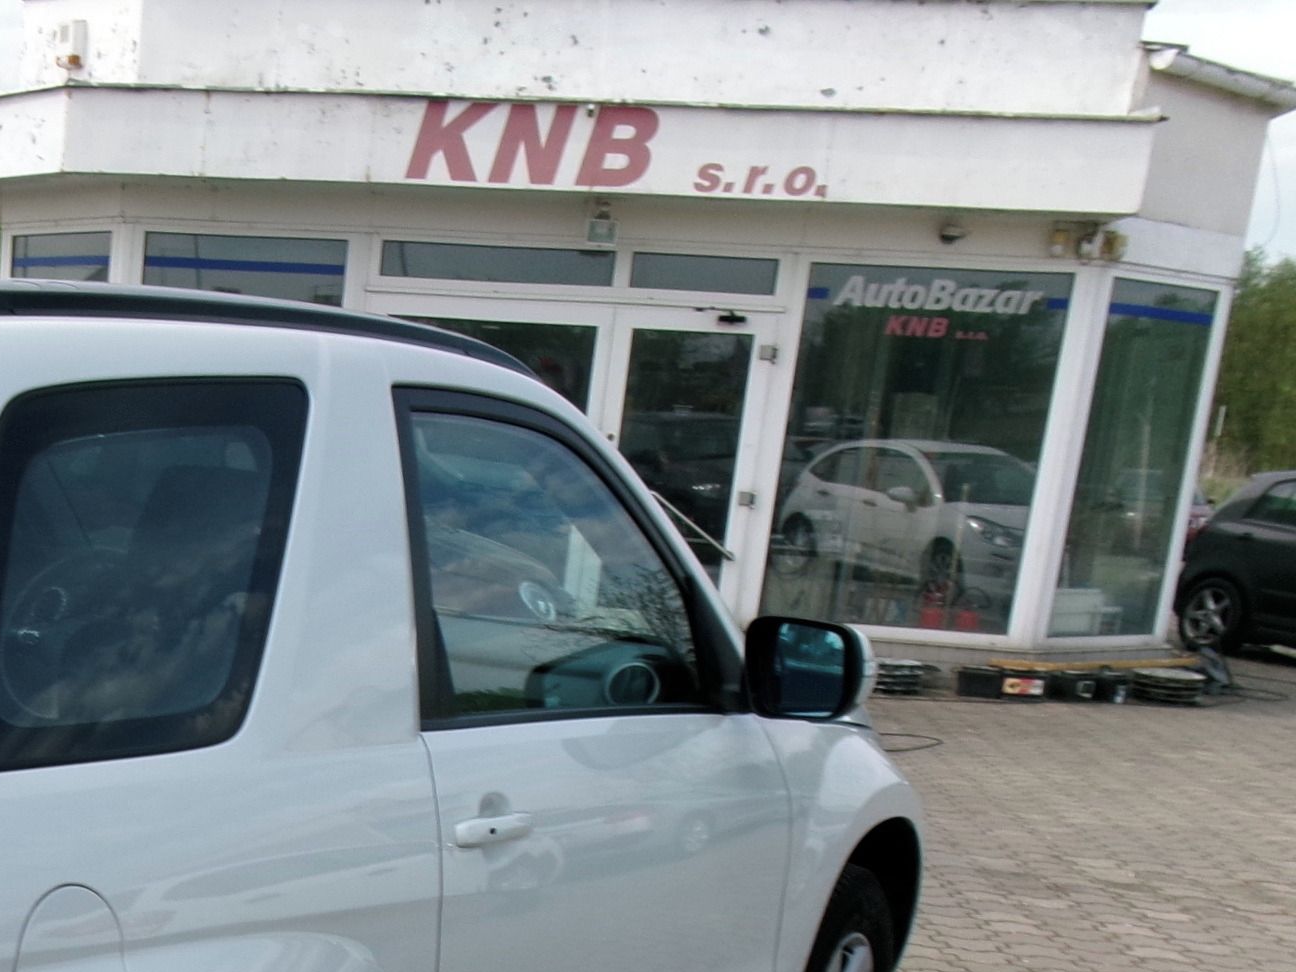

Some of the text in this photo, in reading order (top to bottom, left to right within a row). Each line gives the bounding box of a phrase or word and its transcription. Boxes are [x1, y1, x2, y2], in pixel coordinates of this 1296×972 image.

[406, 100, 828, 198] KNB s.r.o.
[832, 275, 1045, 314] AutoBazar
[883, 316, 950, 338] KNB
